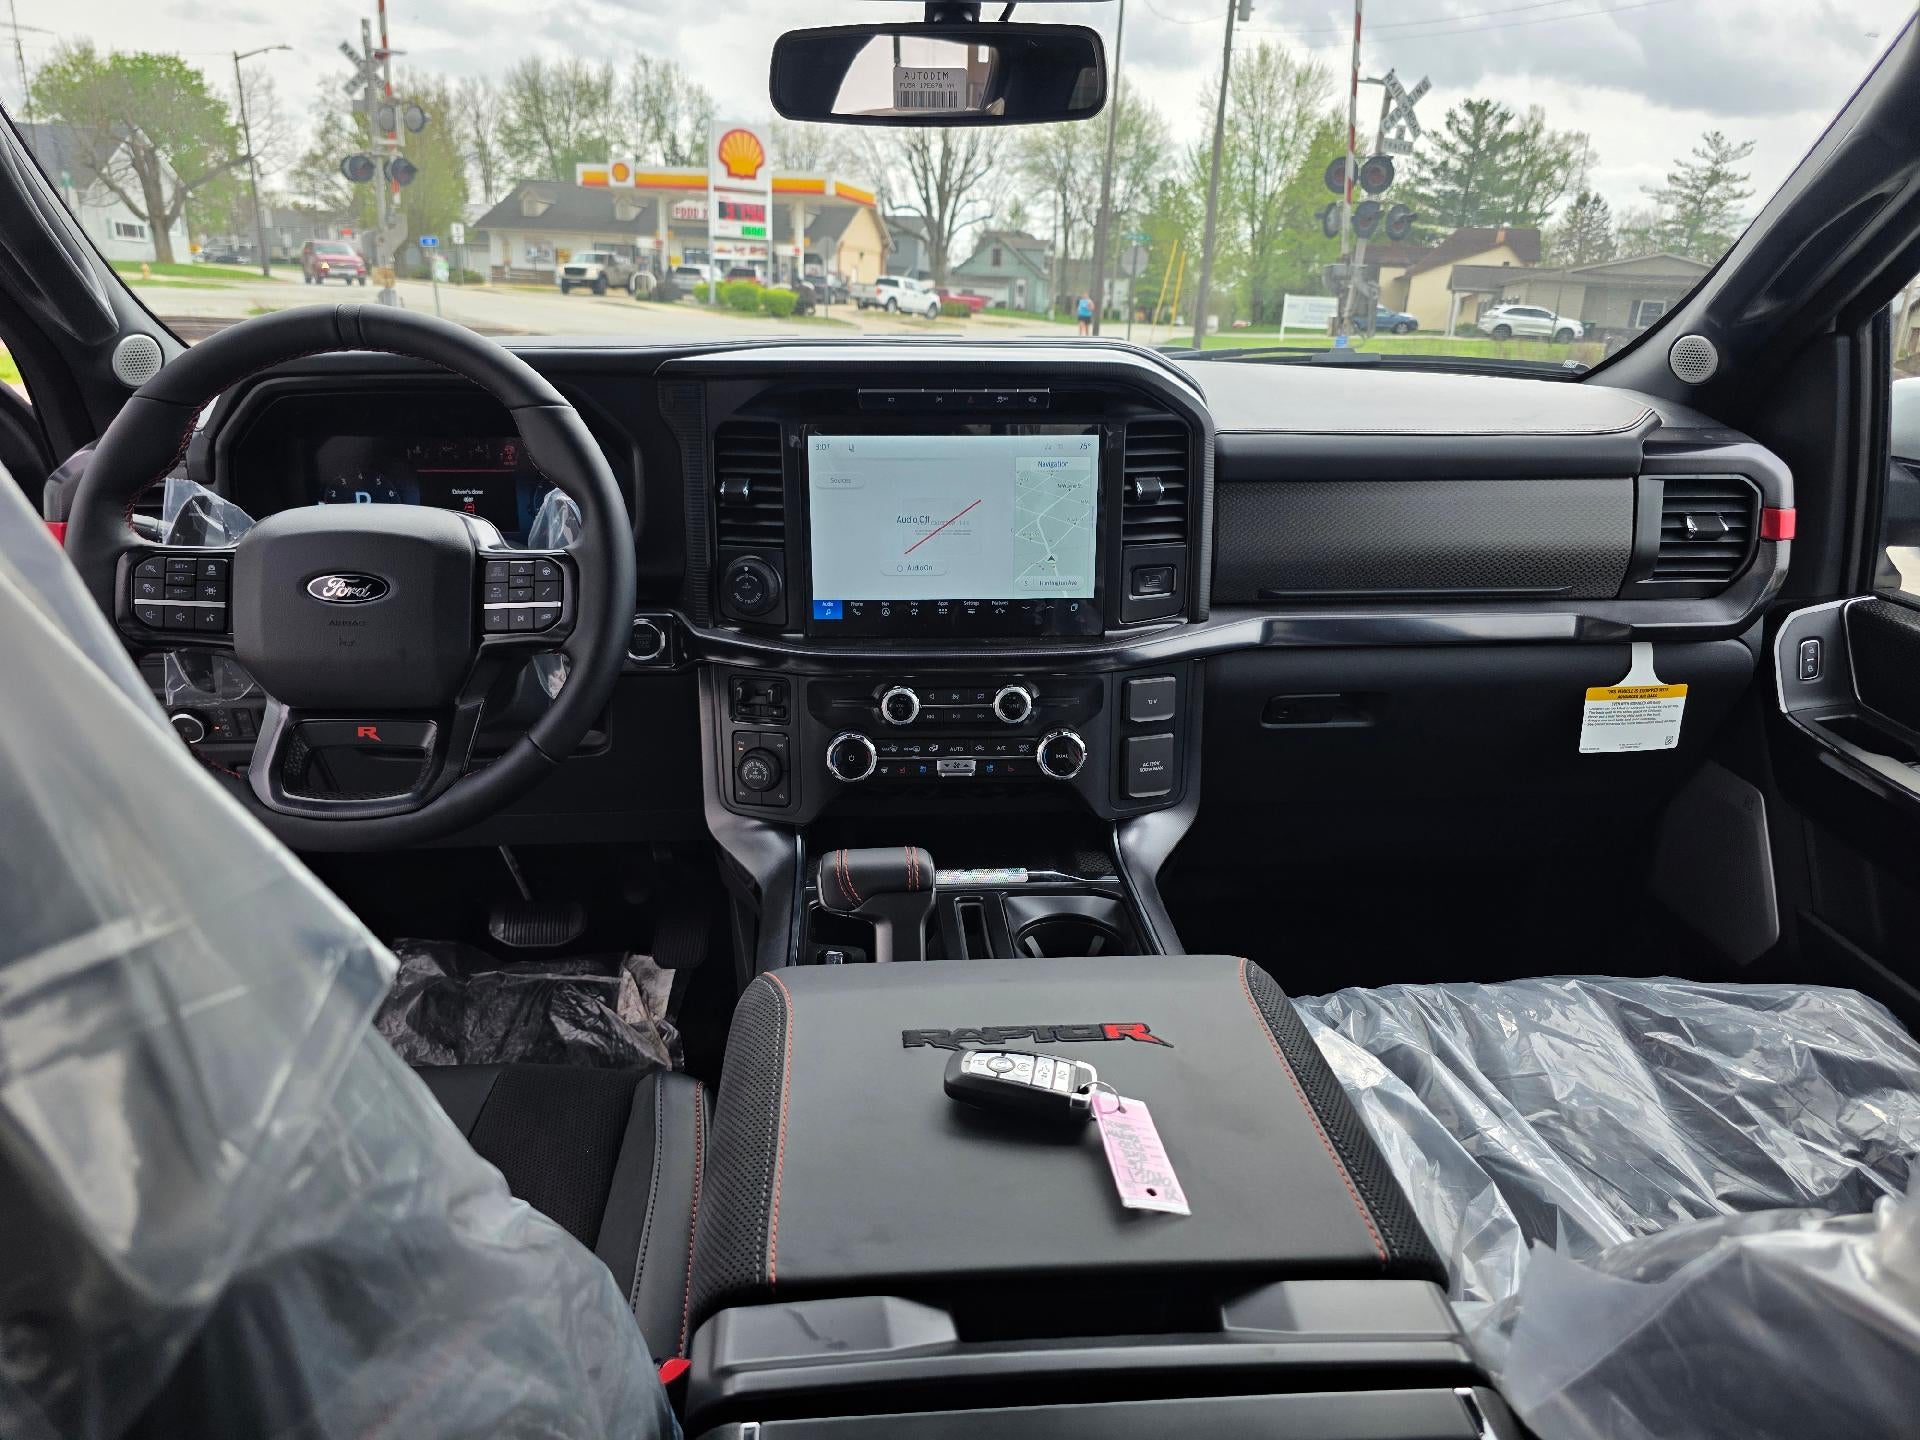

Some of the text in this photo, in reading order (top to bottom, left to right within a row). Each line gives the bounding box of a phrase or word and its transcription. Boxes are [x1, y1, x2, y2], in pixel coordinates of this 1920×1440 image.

[904, 72, 950, 80] AUTODIM
[322, 578, 372, 598] Ford
[902, 1022, 1174, 1050] RAPTOR
